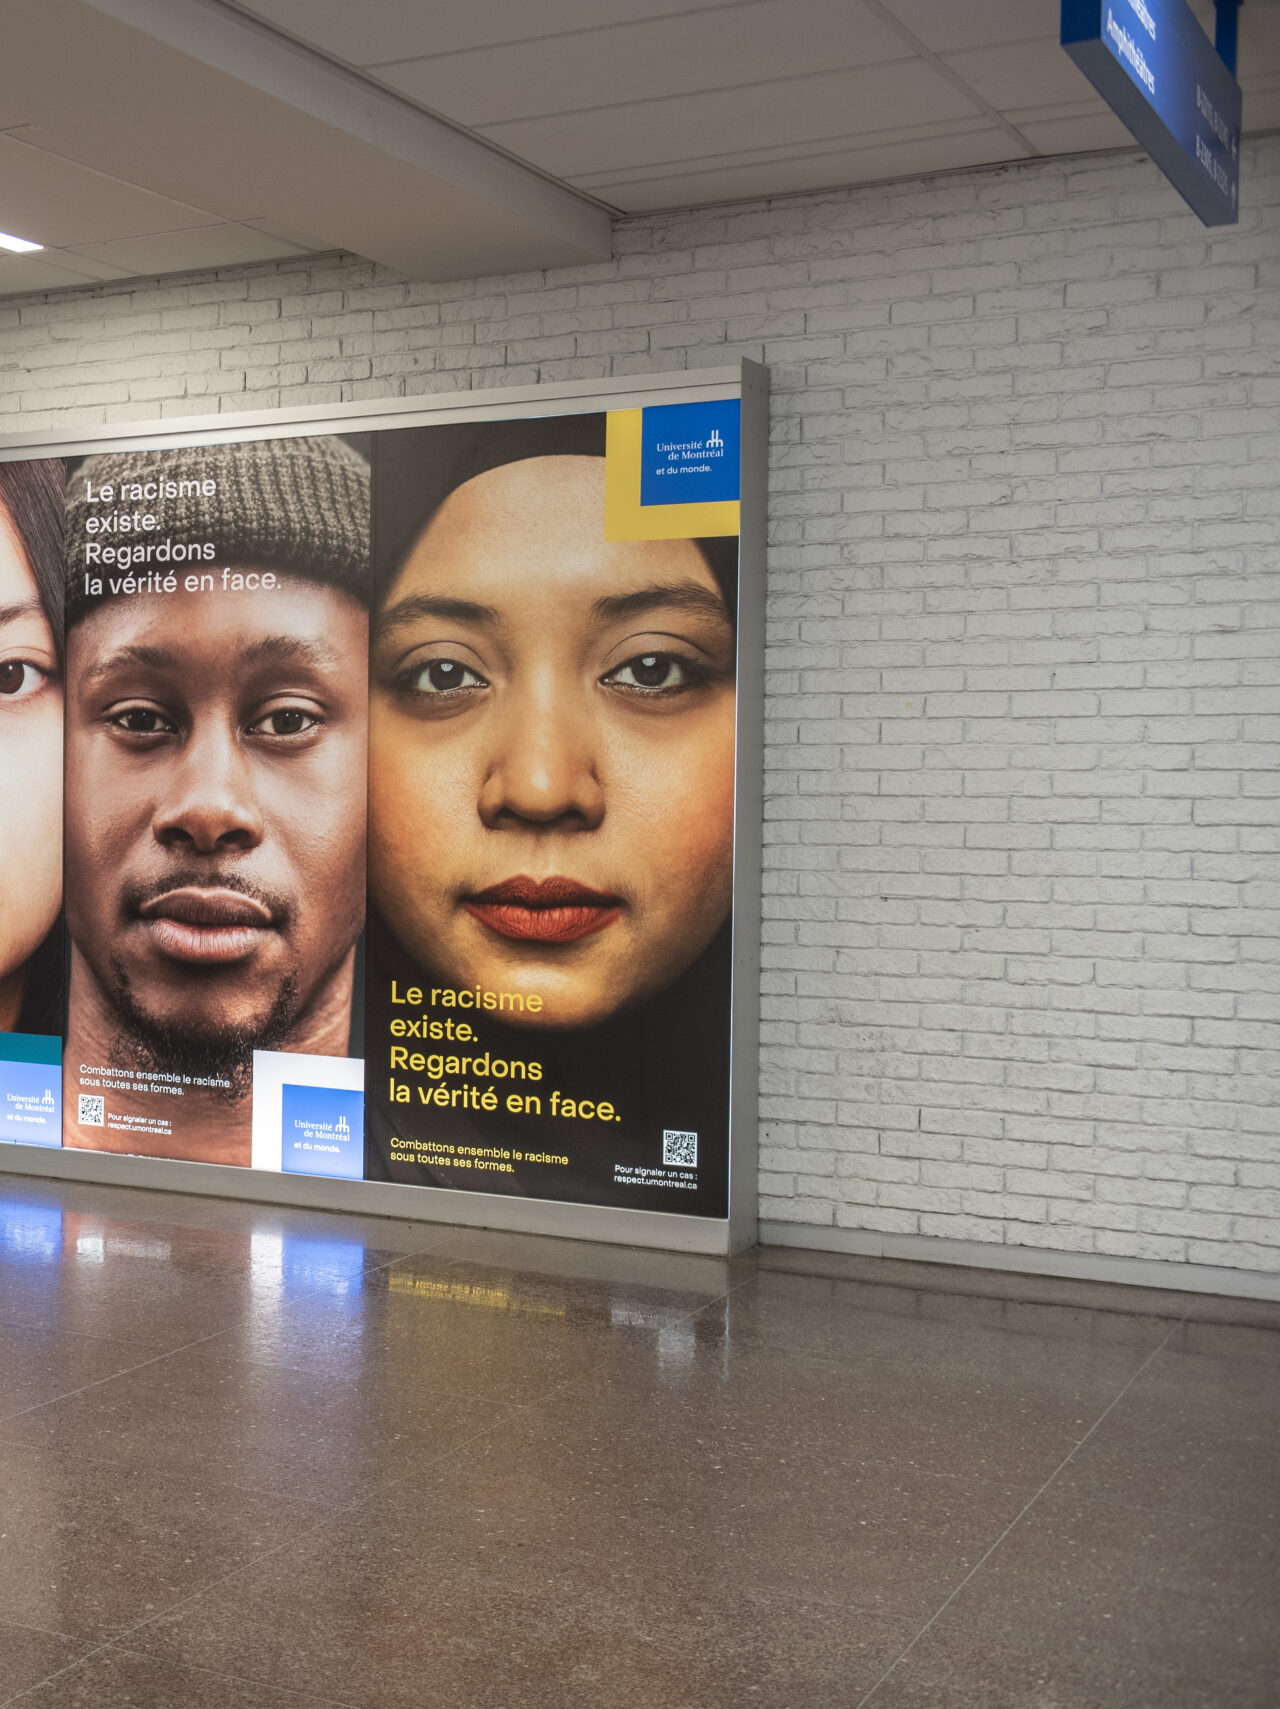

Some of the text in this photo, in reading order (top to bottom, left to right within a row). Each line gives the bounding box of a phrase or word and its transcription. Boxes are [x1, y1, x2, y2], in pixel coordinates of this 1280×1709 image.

[656, 440, 703, 452] Université
[668, 448, 724, 460] de Montréal
[656, 464, 712, 475] et du monde.
[87, 476, 217, 503] Le racisme
[86, 510, 161, 534] existe.
[86, 539, 216, 570] Regardons
[85, 568, 282, 595] la vérité en face.
[391, 980, 543, 1013] Le racisme
[390, 1015, 478, 1042] existe.
[390, 1046, 543, 1081] Regardons
[79, 1064, 230, 1088] Combattons ensemble le racisme
[79, 1077, 185, 1095] sous toutes ses formes.
[7, 1093, 40, 1104] Université
[15, 1102, 55, 1113] de Montréal
[389, 1078, 621, 1122] la vérité en face.
[107, 1113, 122, 1121] Pour
[123, 1114, 147, 1124] signaler
[294, 1120, 333, 1131] Université
[304, 1129, 350, 1142] de Montréal
[390, 1137, 569, 1165] Combattons ensemble le racisme
[390, 1151, 515, 1173] sous toutes ses formes.
[614, 1164, 633, 1173] Pour
[635, 1167, 666, 1177] signaler
[679, 1172, 693, 1180] cas
[614, 1175, 698, 1190] respect.umontreal.ca
